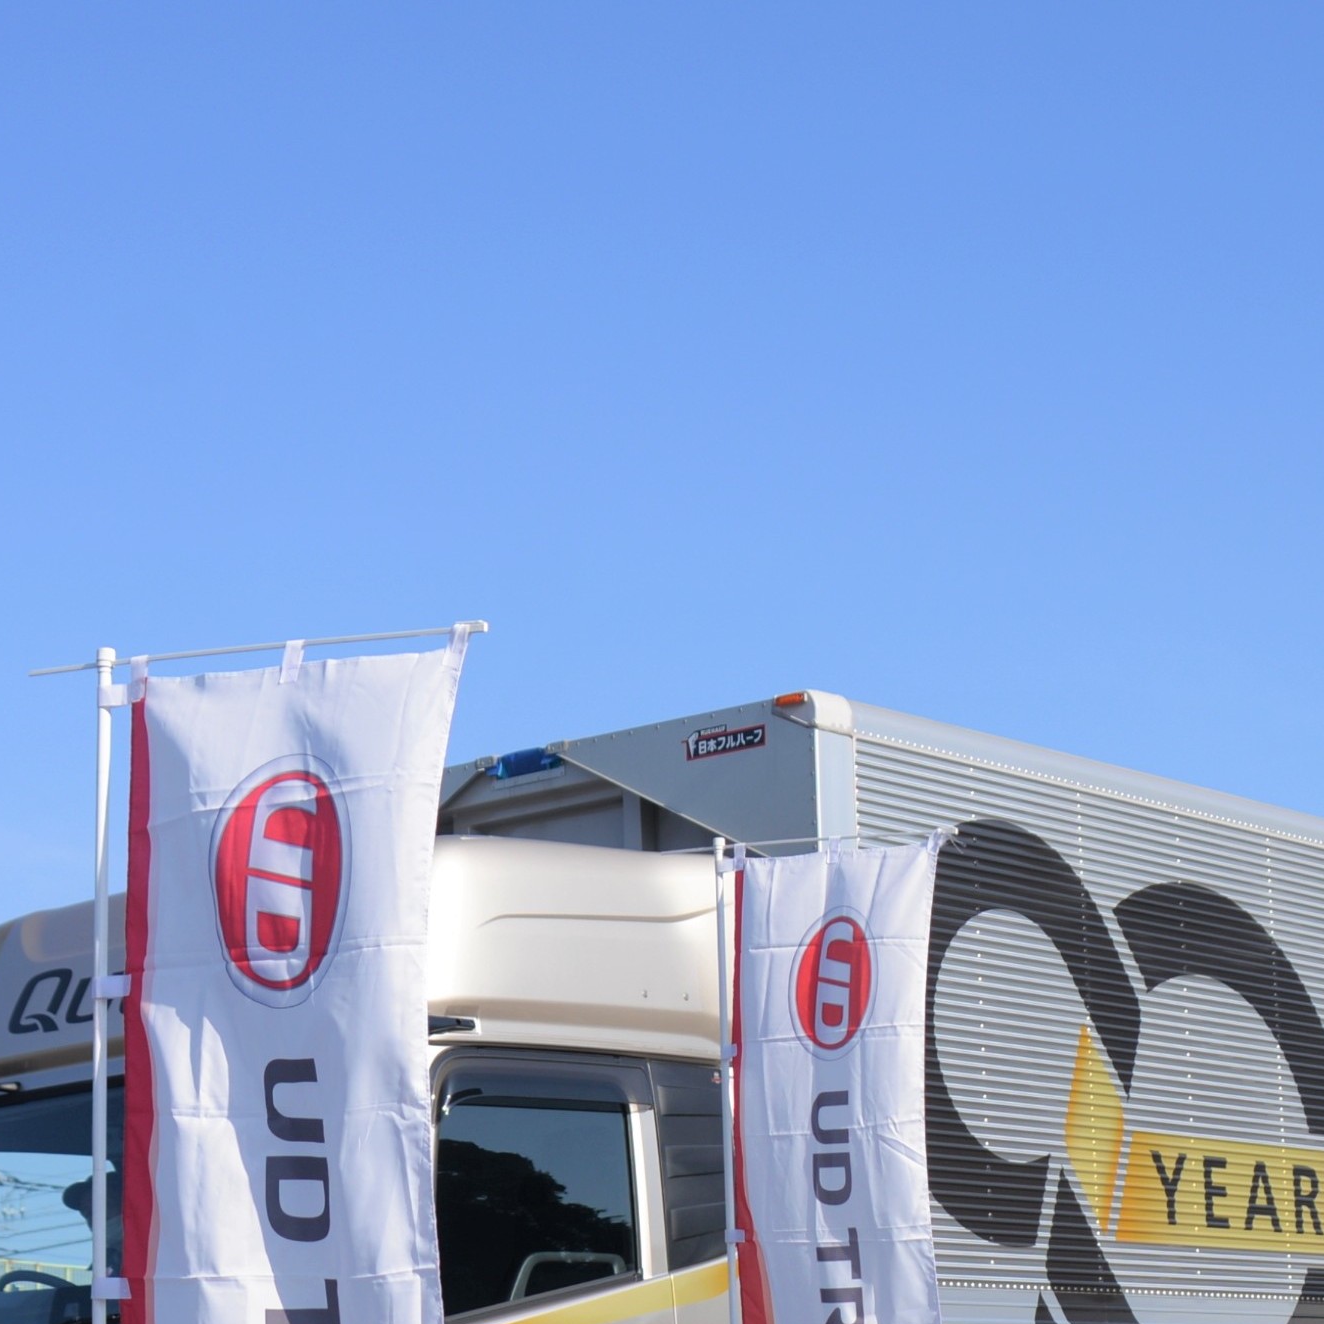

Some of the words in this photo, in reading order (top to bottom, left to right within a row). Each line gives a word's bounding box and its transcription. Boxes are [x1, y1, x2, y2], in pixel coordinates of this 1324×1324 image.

[698, 728, 763, 755] 日本フルハーフ
[263, 1057, 332, 1243] UD
[810, 1089, 853, 1206] UD
